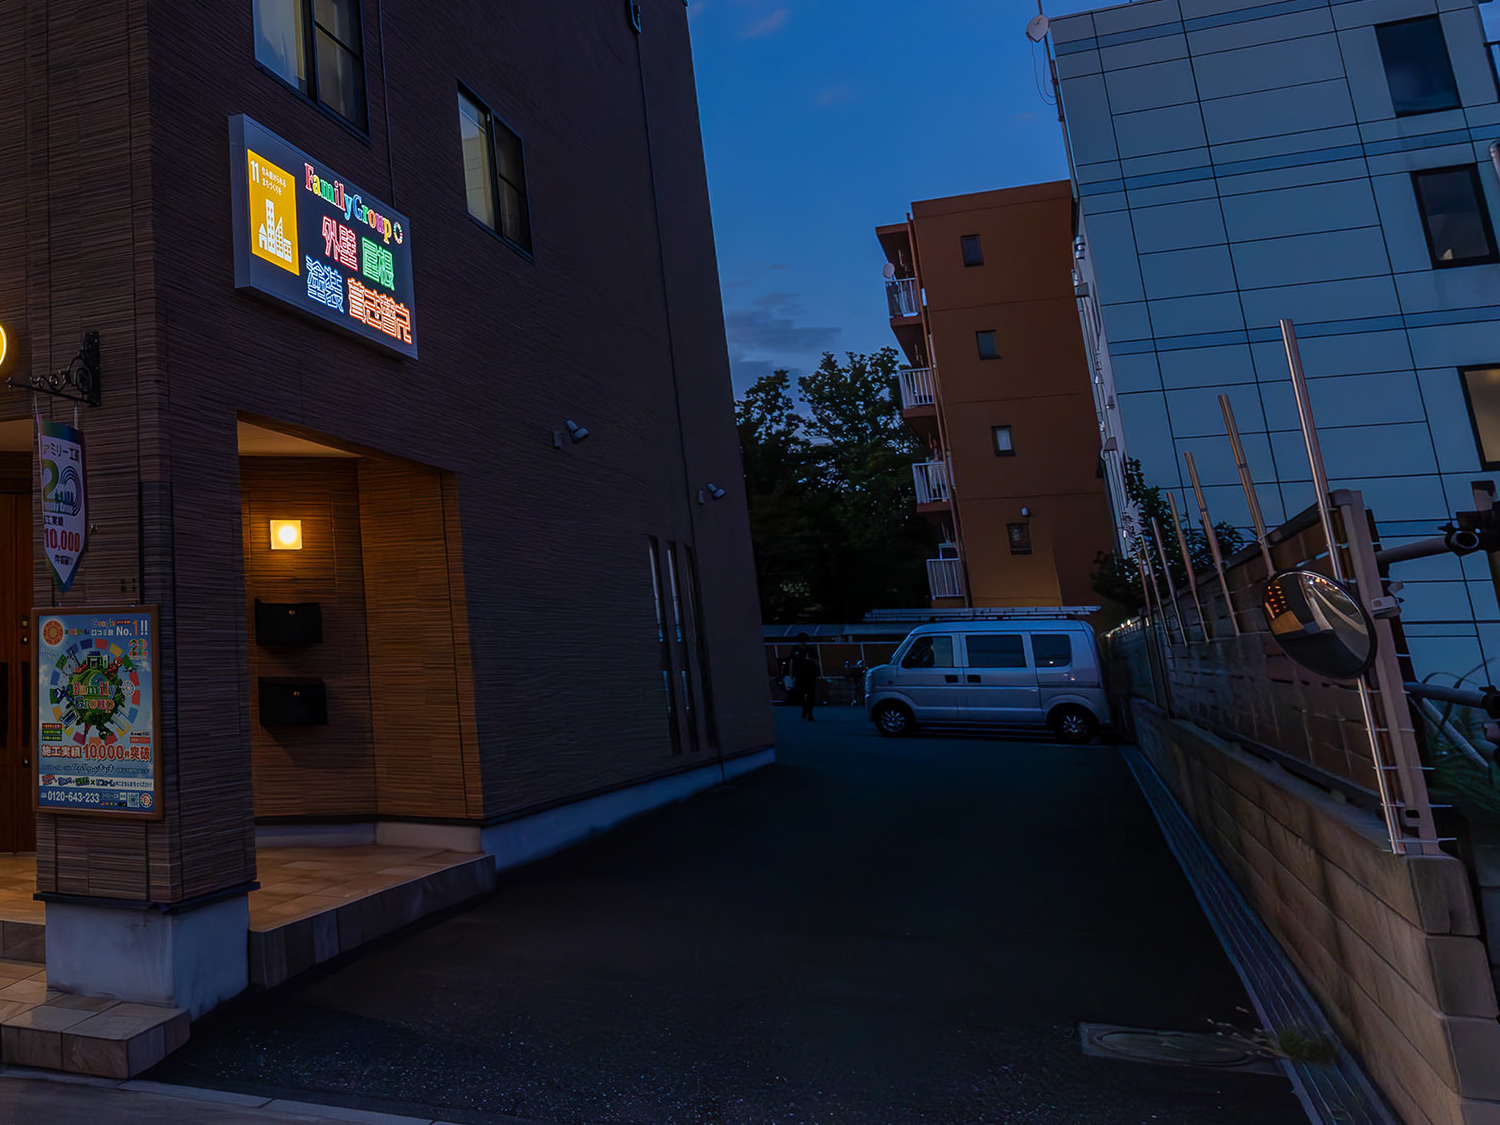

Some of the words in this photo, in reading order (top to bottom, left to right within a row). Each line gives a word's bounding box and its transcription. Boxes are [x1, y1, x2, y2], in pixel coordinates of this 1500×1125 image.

[250, 160, 260, 184] 11
[73, 681, 118, 699] Family
[74, 696, 115, 714] Group
[47, 790, 100, 804] 0120-643-233
